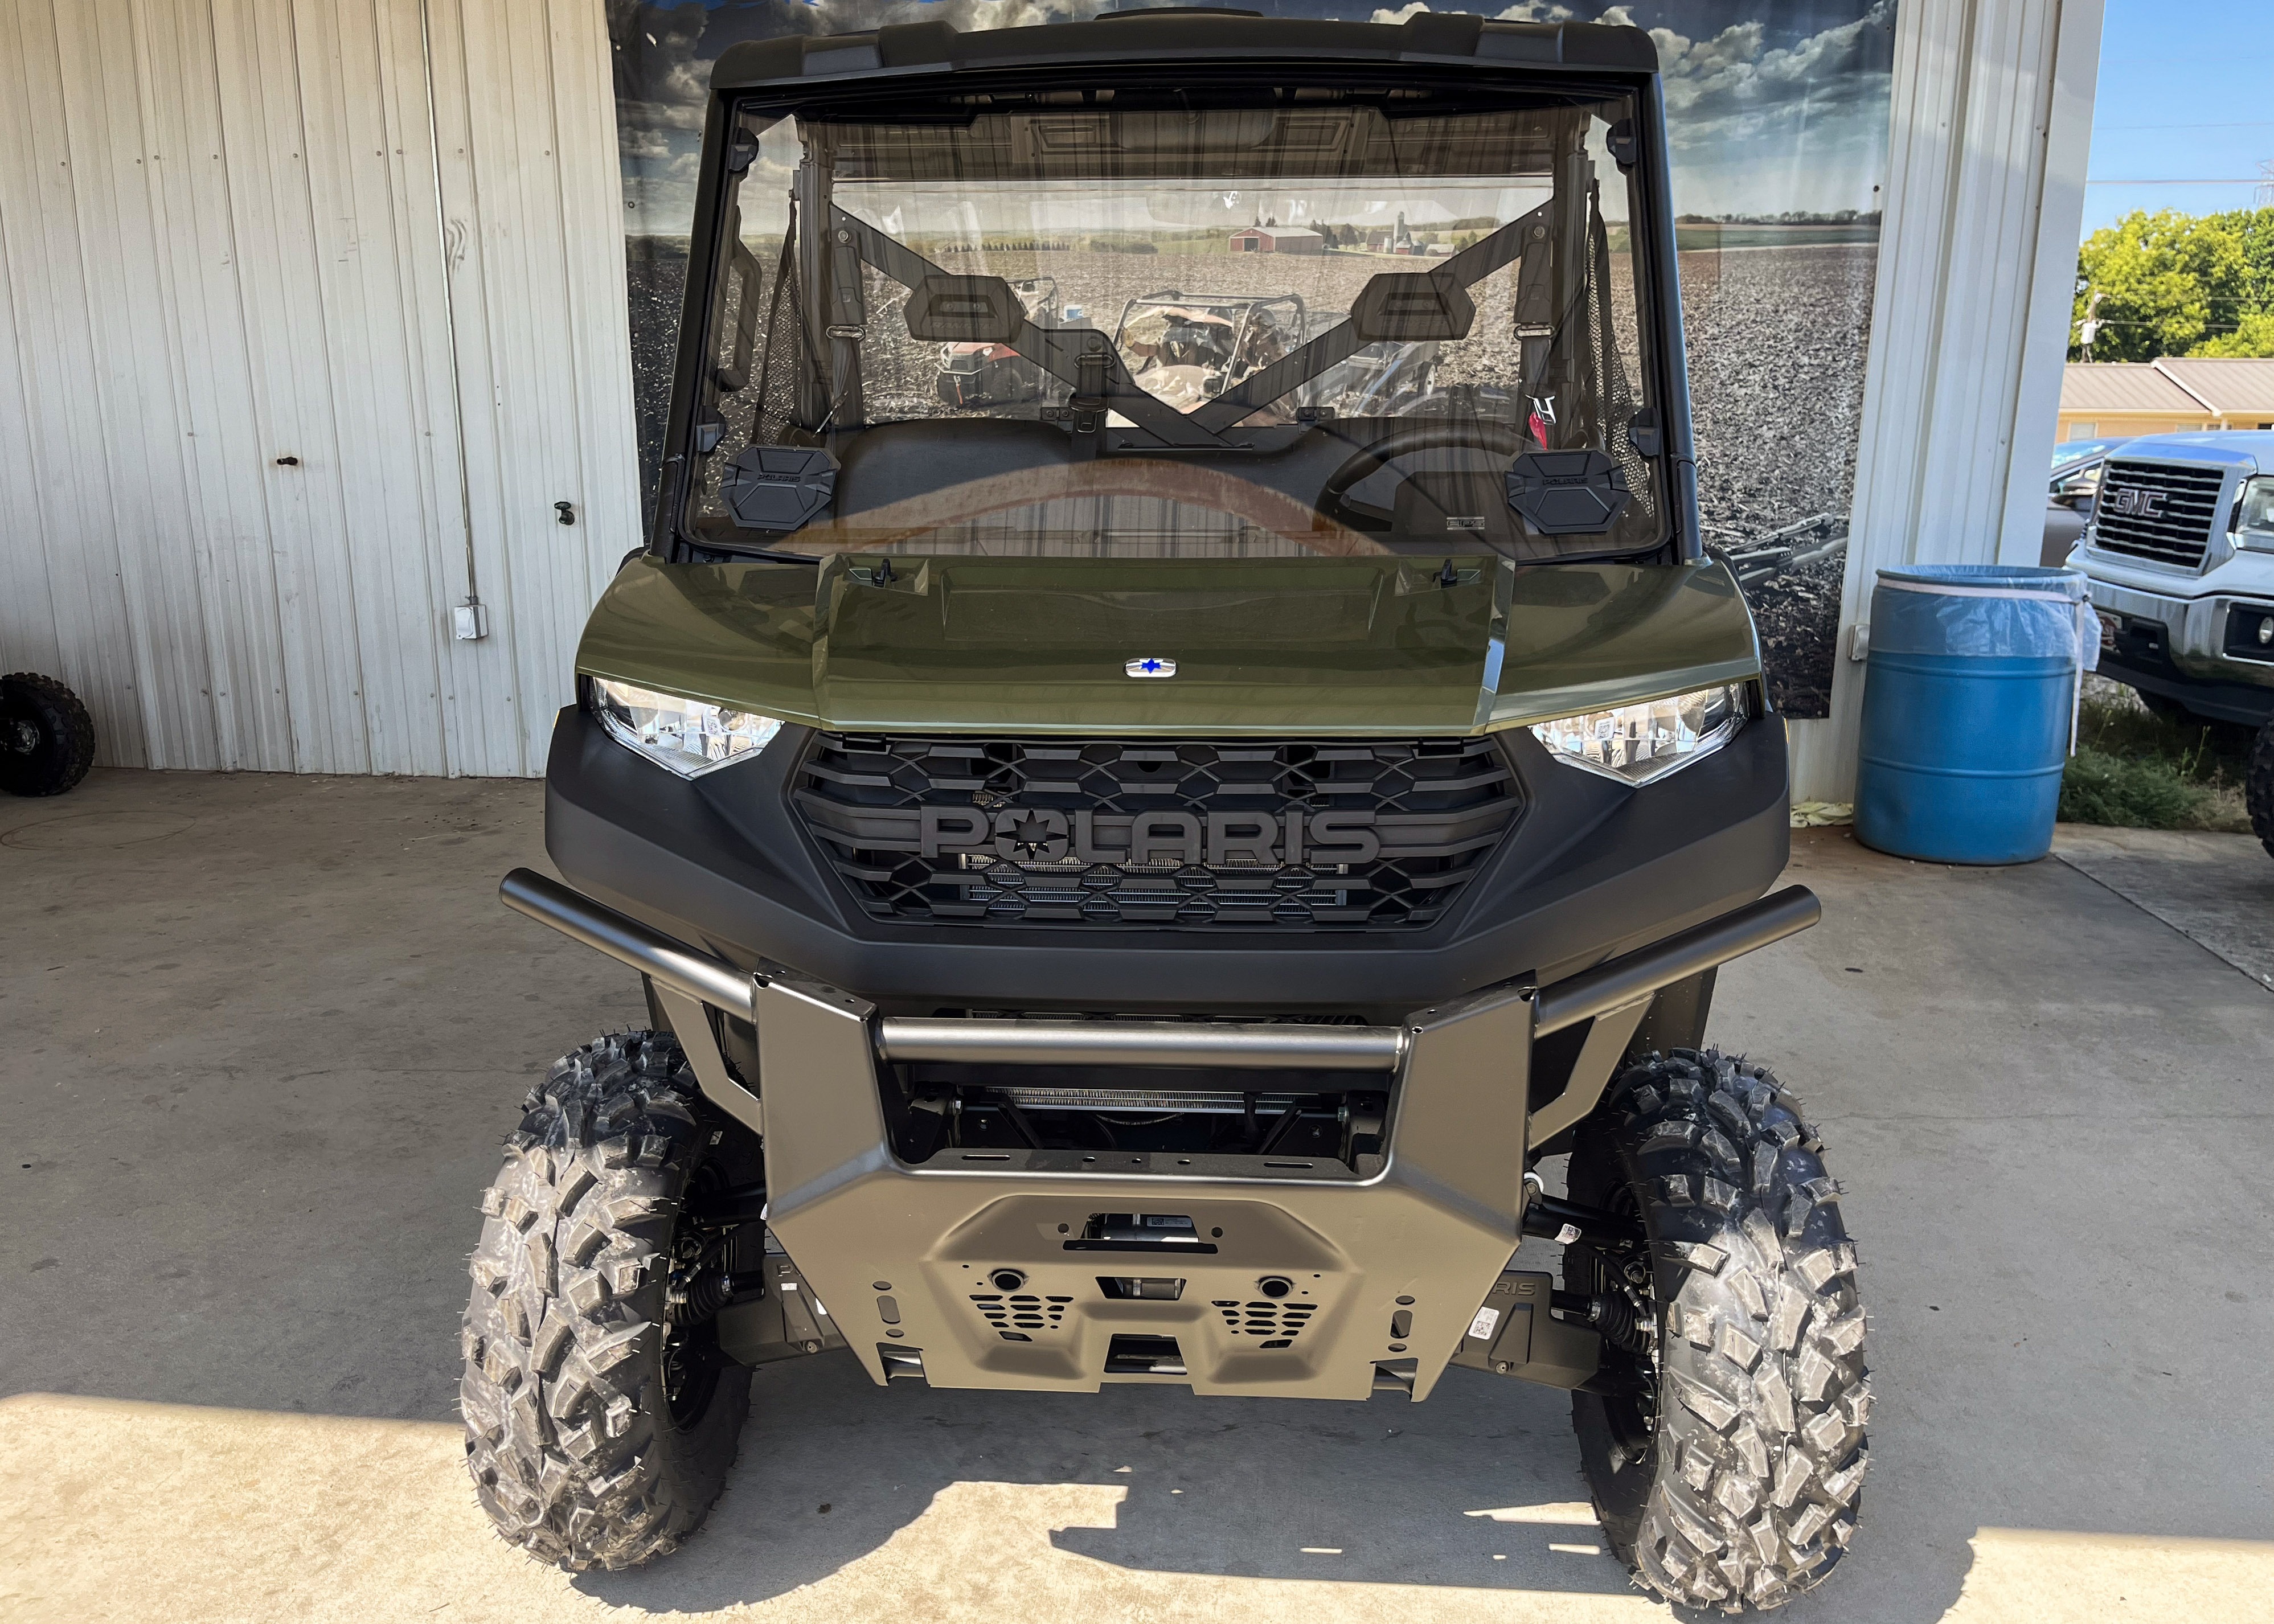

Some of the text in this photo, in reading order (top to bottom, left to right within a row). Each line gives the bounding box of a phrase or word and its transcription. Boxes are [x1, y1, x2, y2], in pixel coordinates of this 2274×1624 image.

[756, 474, 801, 482] POLARIS
[2113, 488, 2167, 518] GMC
[920, 804, 1379, 866] POLARIS
